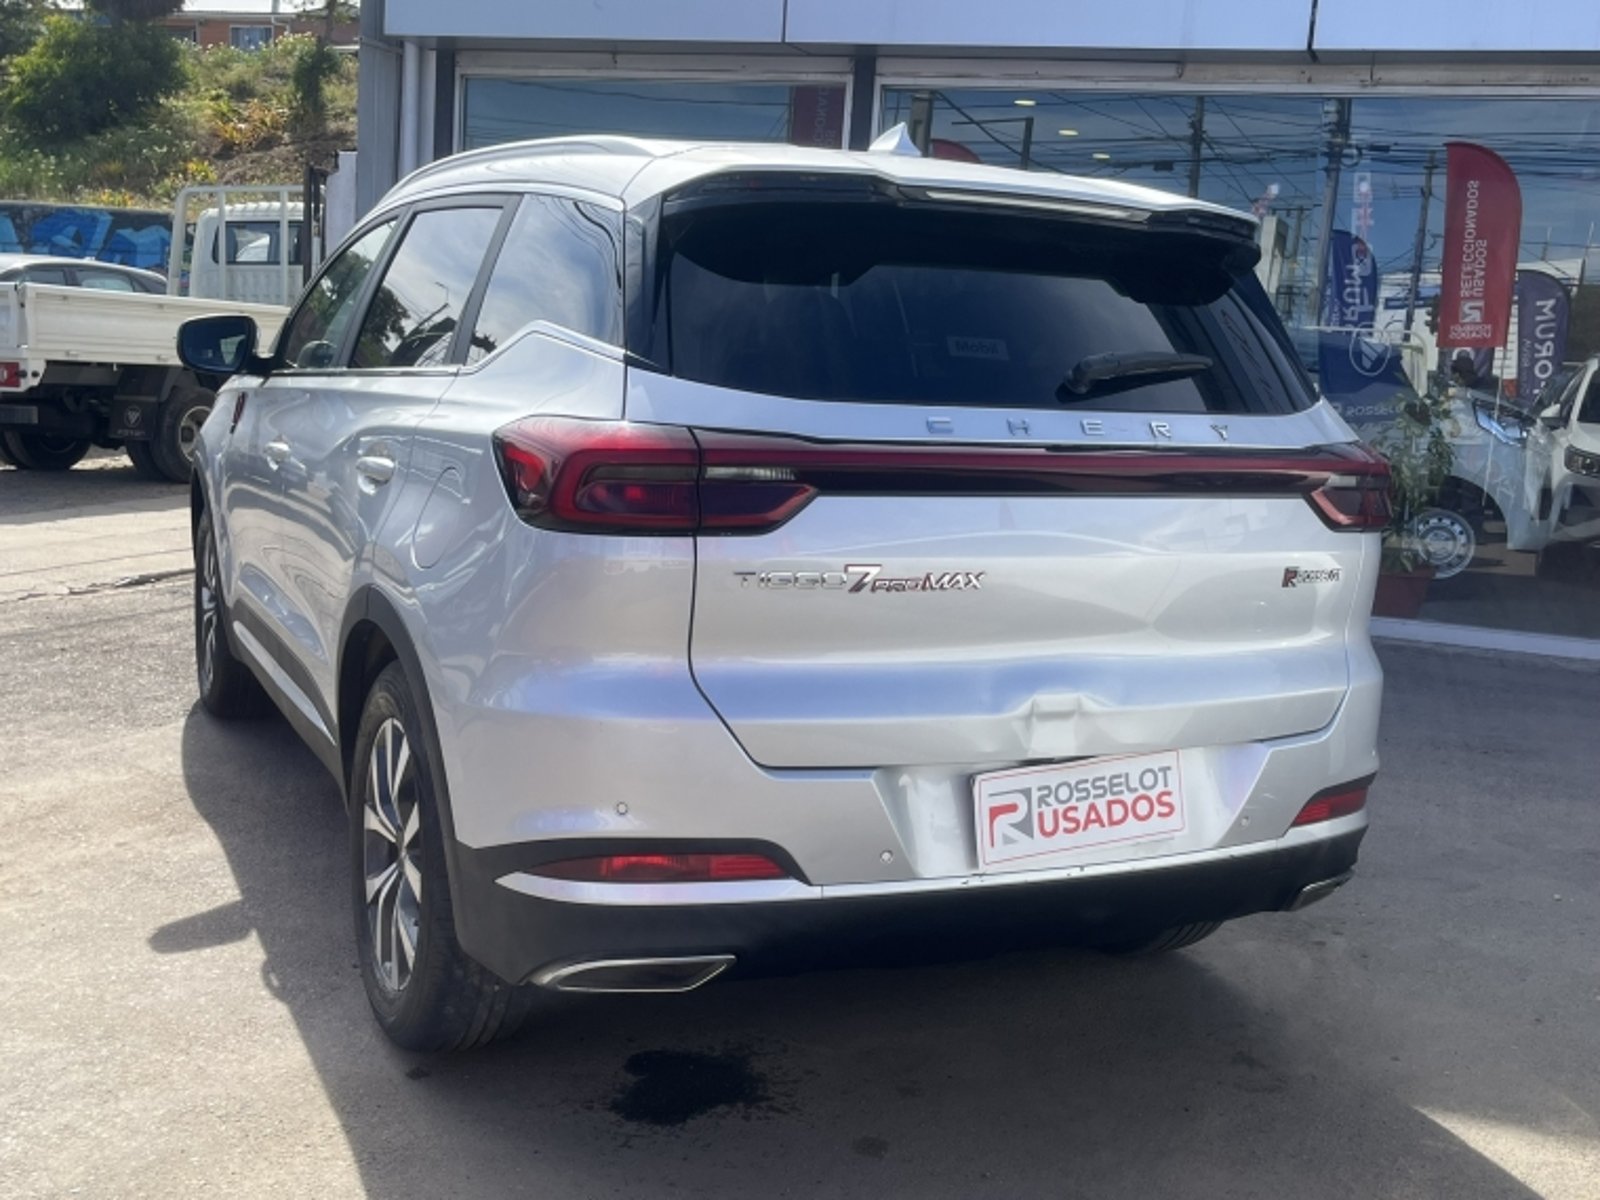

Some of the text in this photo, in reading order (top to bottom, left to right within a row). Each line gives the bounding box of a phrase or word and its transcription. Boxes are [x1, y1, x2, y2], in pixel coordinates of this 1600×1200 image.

[926, 416, 1229, 441] CHERY
[733, 570, 848, 590] TIGGO
[1037, 766, 1172, 809] ROSSELOT
[1038, 791, 1176, 838] USADOS
